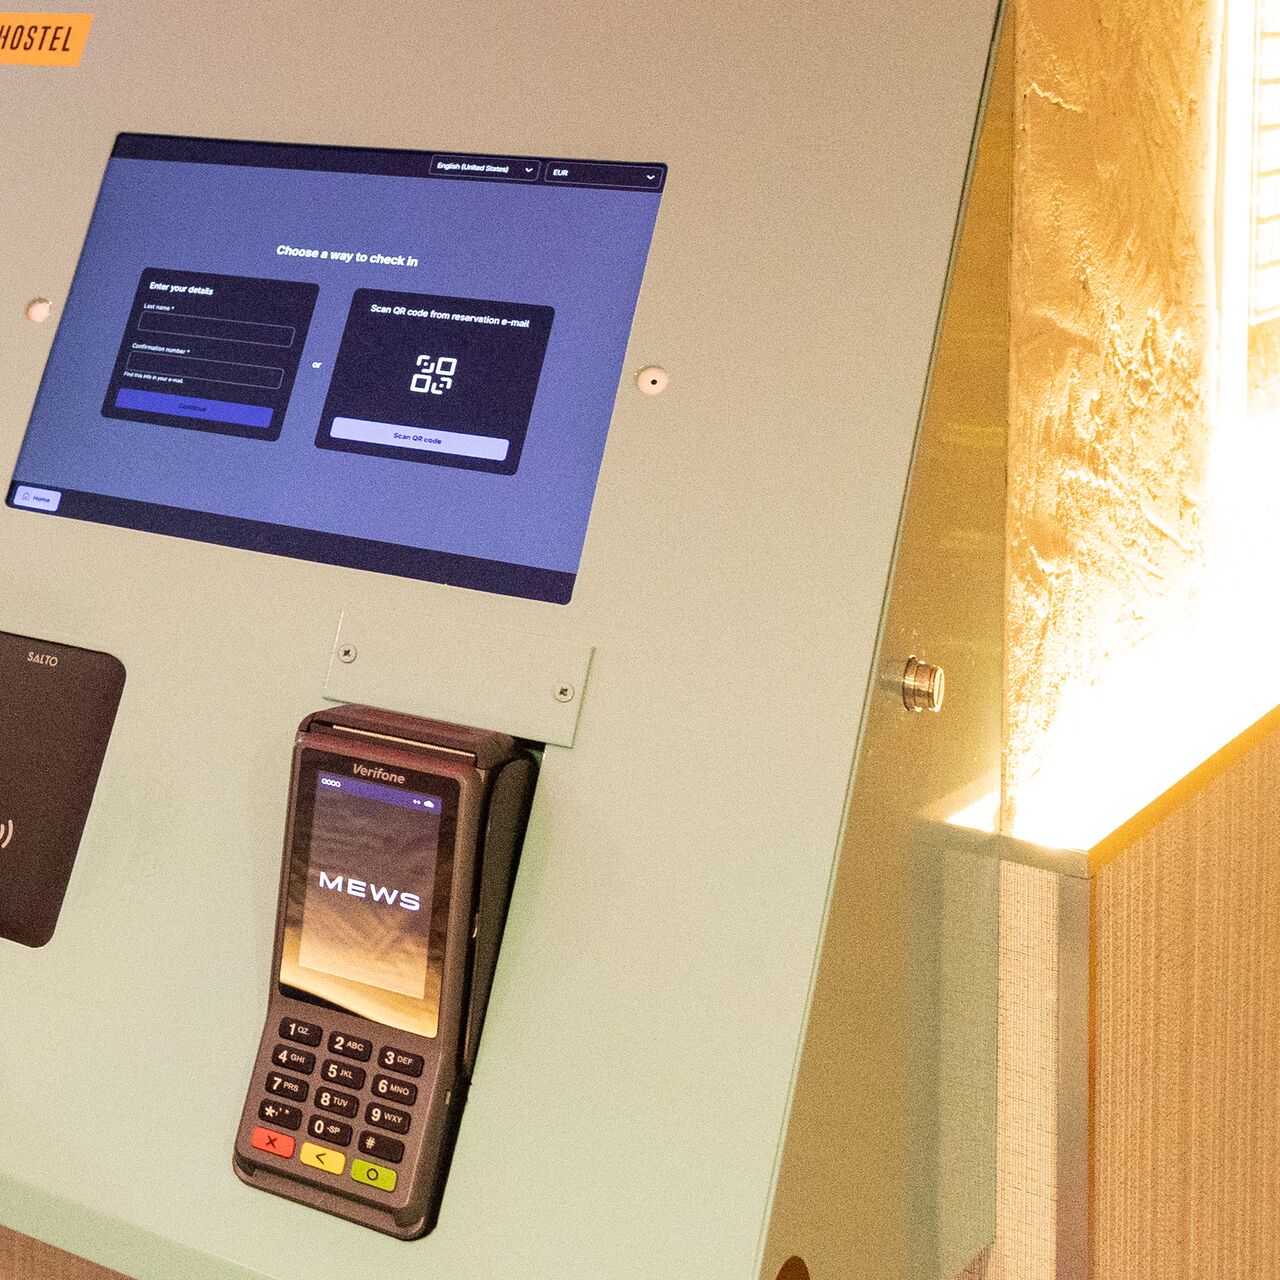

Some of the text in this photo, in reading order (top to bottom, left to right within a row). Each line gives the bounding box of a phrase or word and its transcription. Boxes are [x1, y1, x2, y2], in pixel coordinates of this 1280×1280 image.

[552, 168, 569, 177] EUR
[276, 245, 419, 267] Choose a way to check in
[149, 281, 214, 296] Enter your details
[370, 304, 530, 328] Scan QR code from reservation e-mail
[311, 361, 322, 369] or
[393, 432, 442, 445] Scan QR code
[27, 651, 58, 667] SALTO
[352, 763, 406, 785] Verifone
[319, 871, 421, 911] MEWS
[289, 1023, 296, 1036] 1
[334, 1036, 364, 1052] 2 ABC
[278, 1050, 306, 1064] 4 GHI
[384, 1051, 413, 1066] 3 DEF
[327, 1064, 353, 1079] 5 JKL
[272, 1077, 299, 1092] 7 PRS
[378, 1079, 410, 1095] 6 MNO
[320, 1092, 348, 1107] 8 TUV
[371, 1108, 403, 1124] 9 WXY
[314, 1119, 324, 1134] 0
[365, 1136, 376, 1149] #
